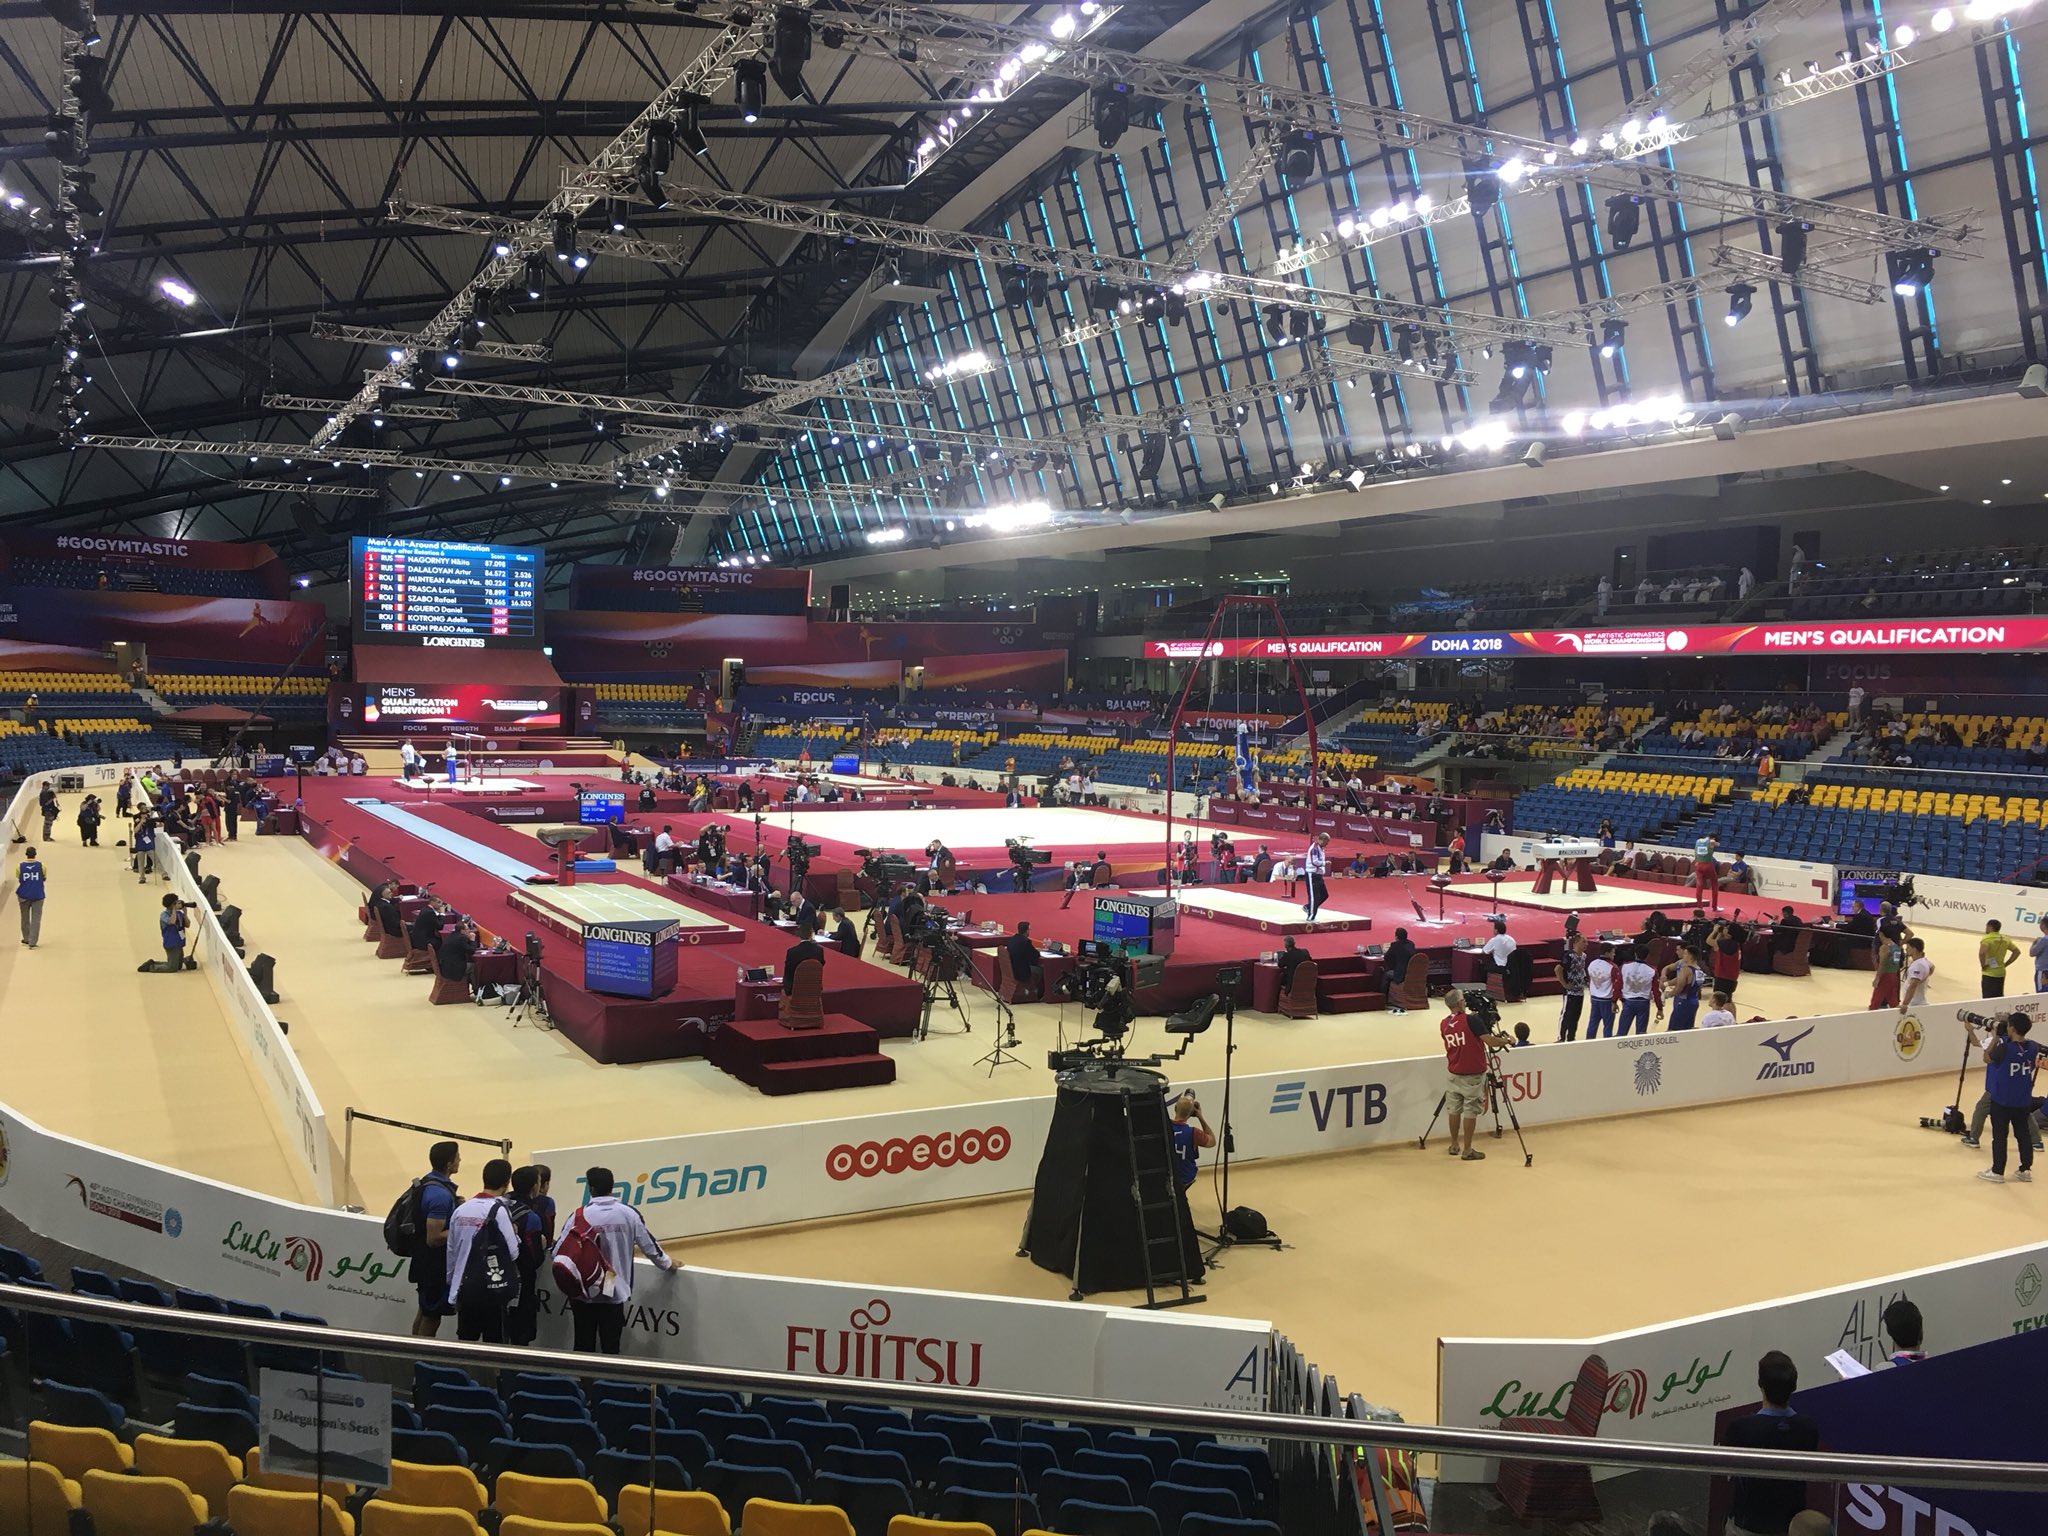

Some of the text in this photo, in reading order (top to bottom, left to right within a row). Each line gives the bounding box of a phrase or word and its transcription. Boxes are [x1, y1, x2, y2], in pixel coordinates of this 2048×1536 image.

[57, 535, 189, 557] #GOGYMTASTIC
[367, 538, 490, 553] Men's All-Around Qualification
[408, 556, 450, 565] NAGORNYY
[408, 566, 453, 575] DALALOYAN
[408, 576, 445, 584] MUNTEAN
[633, 570, 753, 584] #GOGYMTASTIC
[408, 585, 438, 593] FRASCA
[379, 593, 393, 601] ROU
[408, 595, 433, 603] SZABO
[441, 606, 463, 614] Daniel
[408, 614, 446, 622] KOTRONG
[408, 624, 429, 632] LEON
[423, 637, 485, 648] LONGINES
[1764, 626, 2005, 647] MEN'S QUALIFICATION
[1268, 641, 1382, 653] MEN'S QUALIFICATION
[1432, 638, 1503, 651] DOHA 2018
[1826, 664, 1892, 680] FOCUS
[381, 687, 416, 697] MEN'S
[793, 692, 836, 703] FOCUS
[381, 697, 458, 707] QUALIFICATION
[1106, 699, 1151, 711] BALANCE
[381, 706, 451, 715] SUBDIVISION 1
[101, 768, 116, 781] VTB
[22, 872, 40, 881] PH
[1095, 898, 1150, 918] LONGINES
[1942, 899, 1988, 914] AIRWAYS
[583, 925, 651, 946] LONGINES
[2015, 1002, 2040, 1013] SPORT
[1446, 1031, 1466, 1048] RH
[1617, 1036, 1680, 1050] CIRQUE DU SOLEIL
[2009, 1062, 2032, 1077] PH
[1308, 1082, 1388, 1133] VTB
[828, 1128, 1009, 1178] ooredoo
[1652, 1349, 1733, 1402] لولو
[1230, 1393, 1259, 1402] PURE
[1203, 1401, 1258, 1412] ALKALINE
[349, 1421, 380, 1437] Seats
